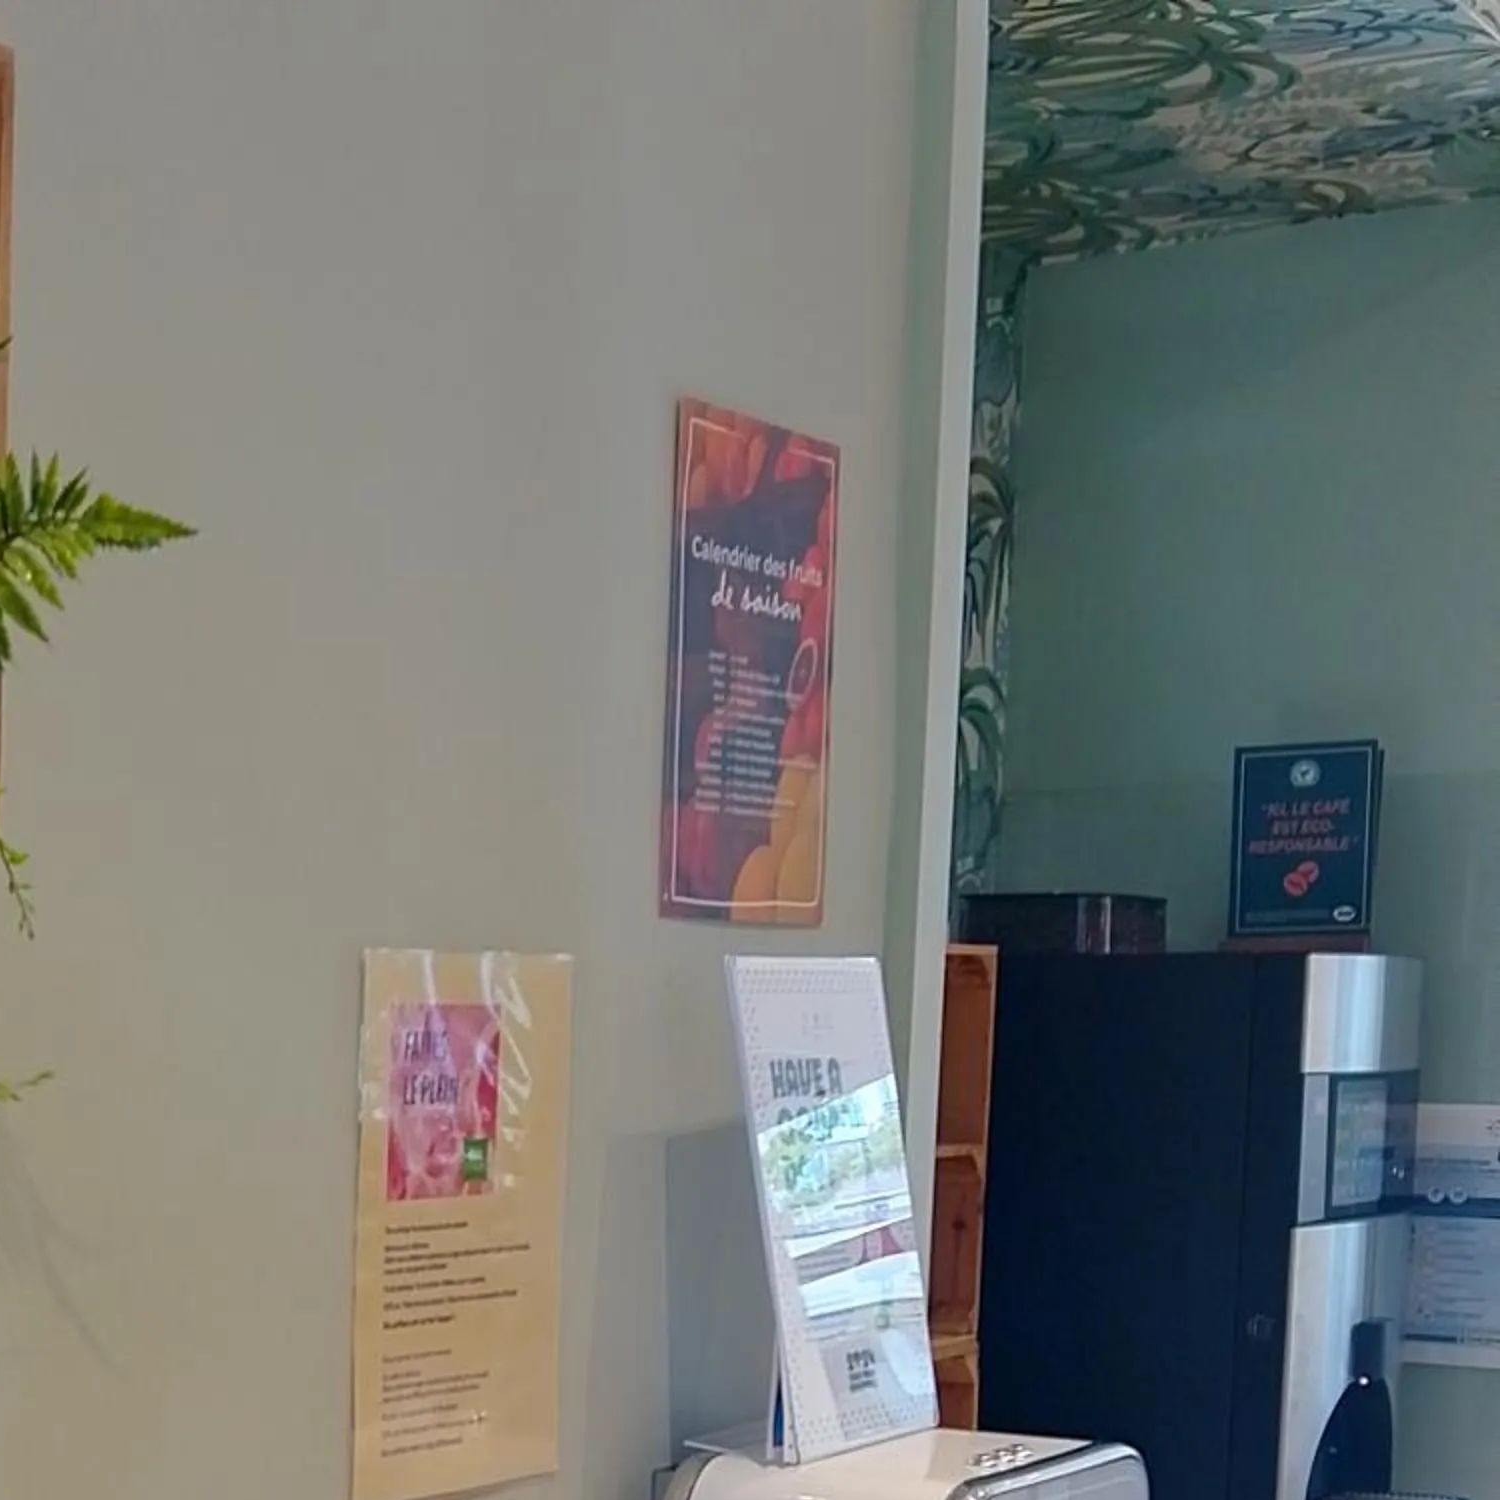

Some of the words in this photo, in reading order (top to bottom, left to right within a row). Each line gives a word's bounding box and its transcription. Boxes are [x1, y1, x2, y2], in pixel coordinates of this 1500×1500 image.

[691, 535, 761, 573] Calendrier
[763, 552, 787, 580] des
[788, 558, 823, 587] fruits
[711, 569, 735, 611] de
[740, 584, 802, 621] saison
[770, 1057, 826, 1098] HAVE
[828, 1055, 843, 1095] A
